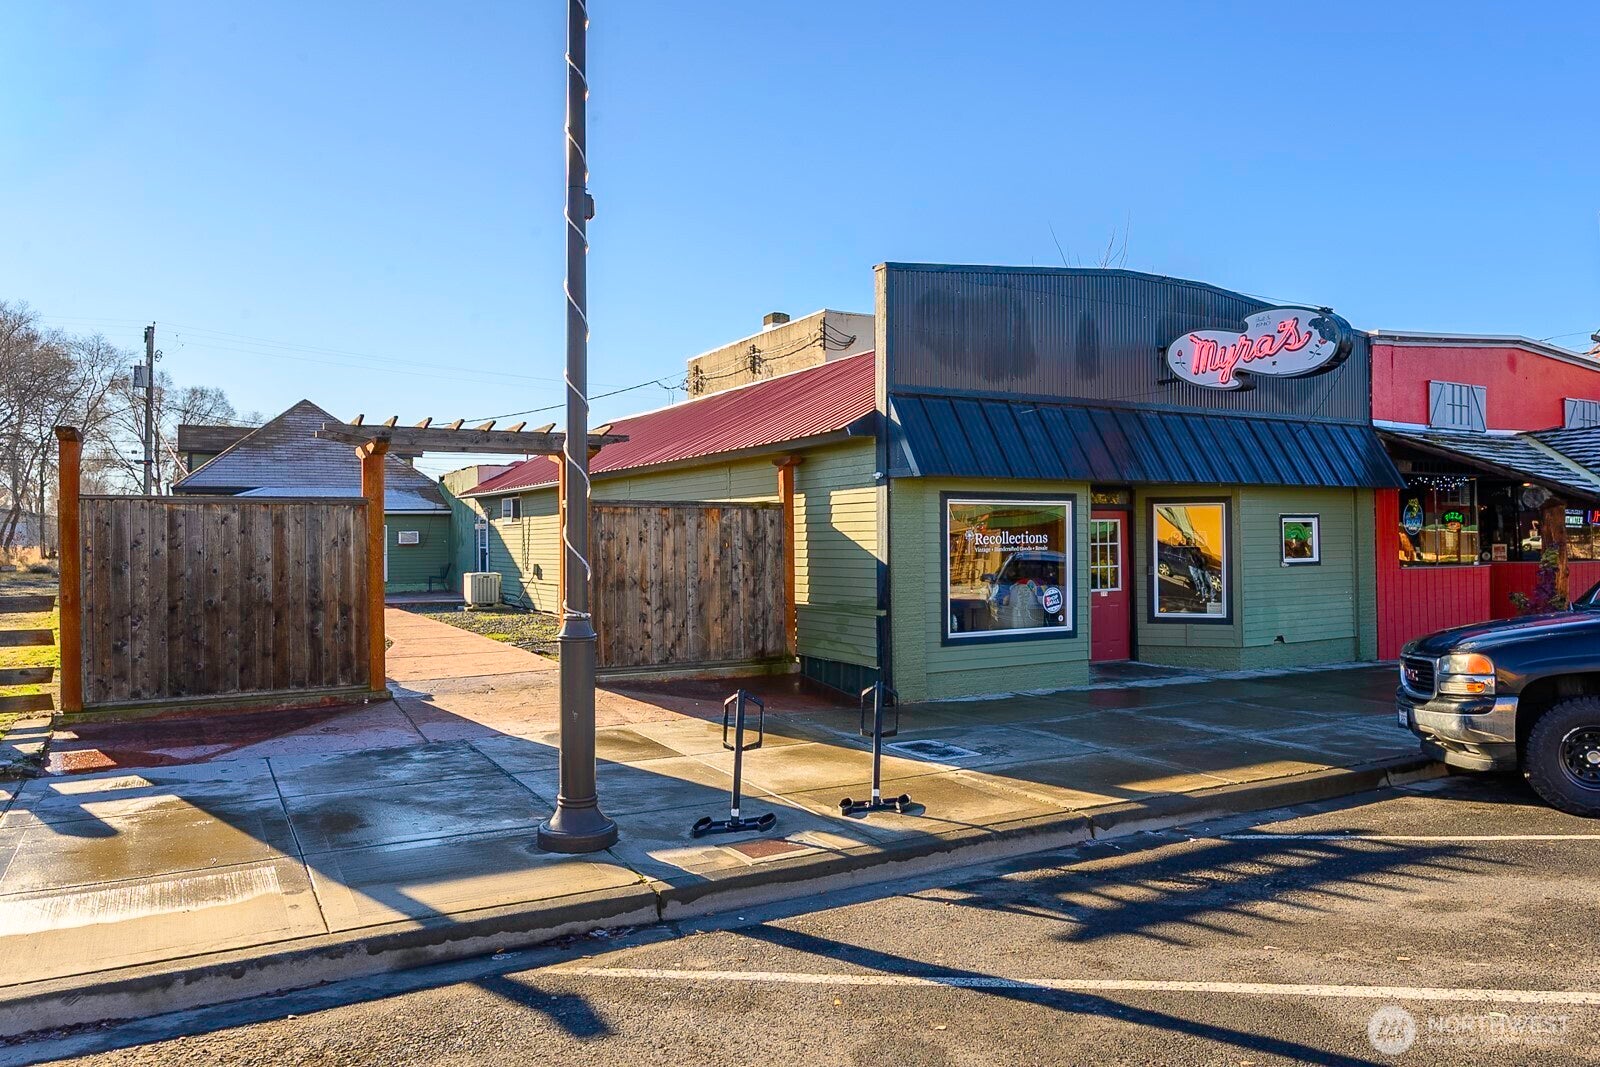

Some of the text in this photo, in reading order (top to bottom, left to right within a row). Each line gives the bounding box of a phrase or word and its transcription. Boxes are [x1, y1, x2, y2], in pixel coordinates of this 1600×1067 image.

[1189, 317, 1313, 385] Myra's
[1444, 511, 1463, 523] PIZZA
[975, 530, 1048, 545] Recollections
